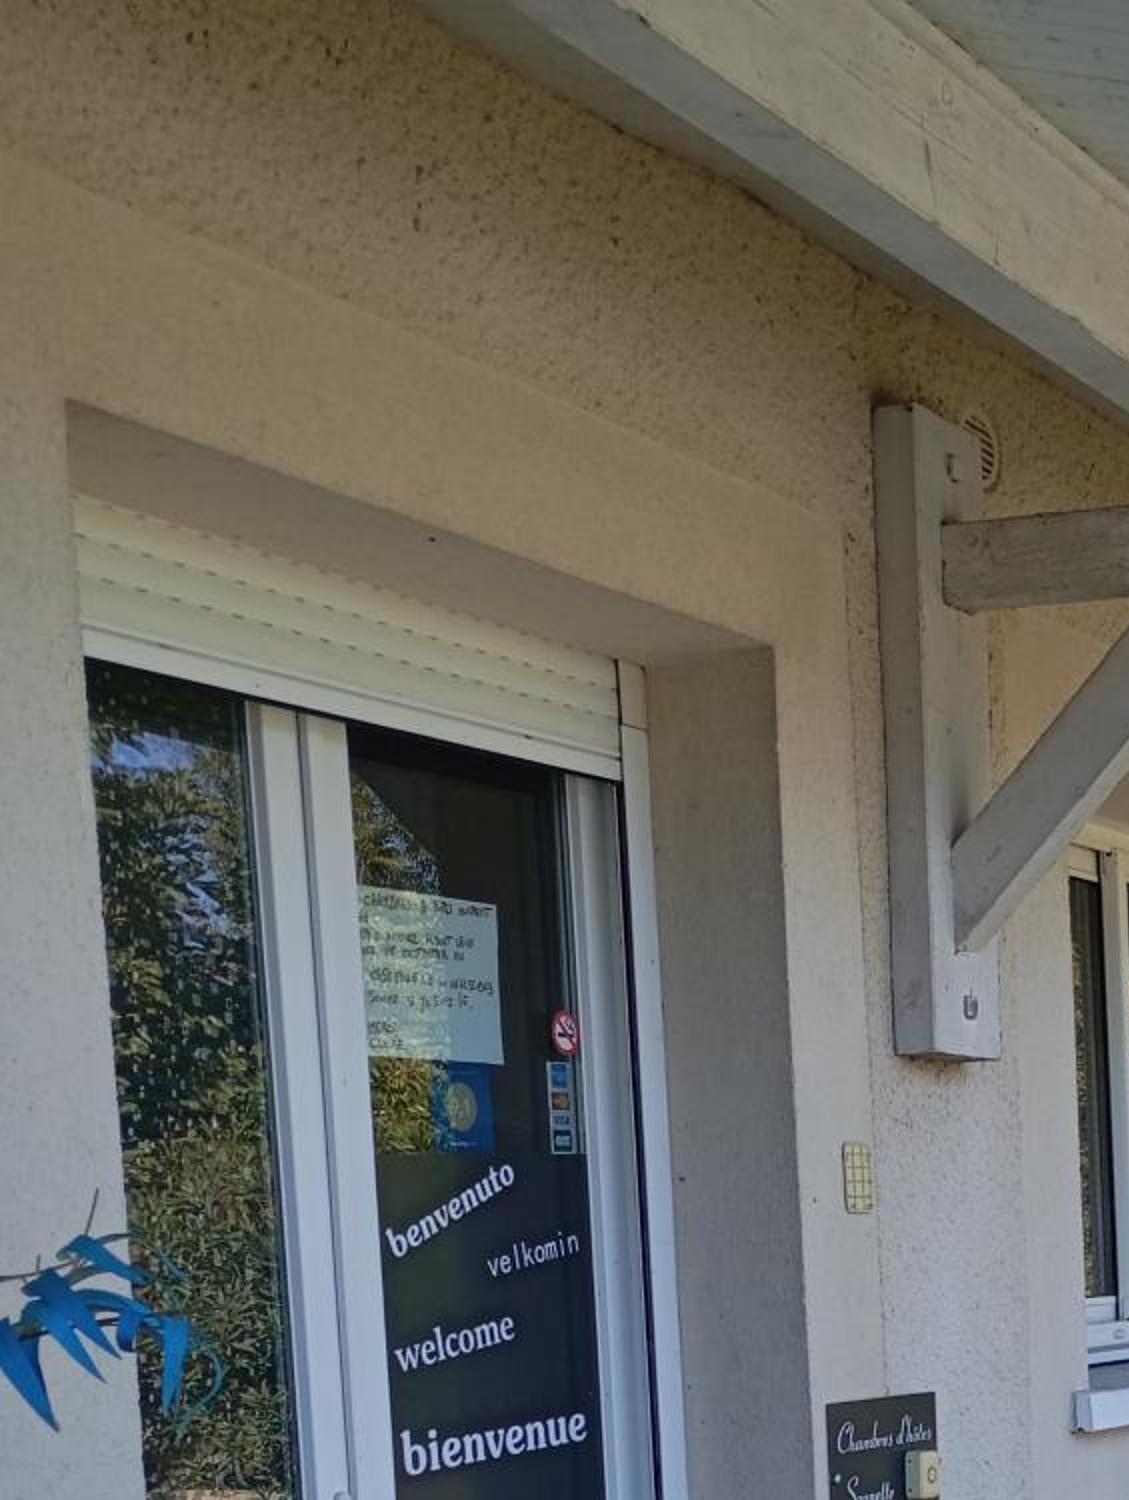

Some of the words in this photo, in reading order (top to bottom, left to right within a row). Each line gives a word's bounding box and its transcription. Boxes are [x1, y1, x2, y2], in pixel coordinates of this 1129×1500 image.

[386, 1163, 515, 1258] benvenuto
[487, 1231, 580, 1278] velkomin
[395, 1316, 516, 1373] welcome
[401, 1413, 587, 1476] bienvenue
[837, 1420, 893, 1454] Chambres
